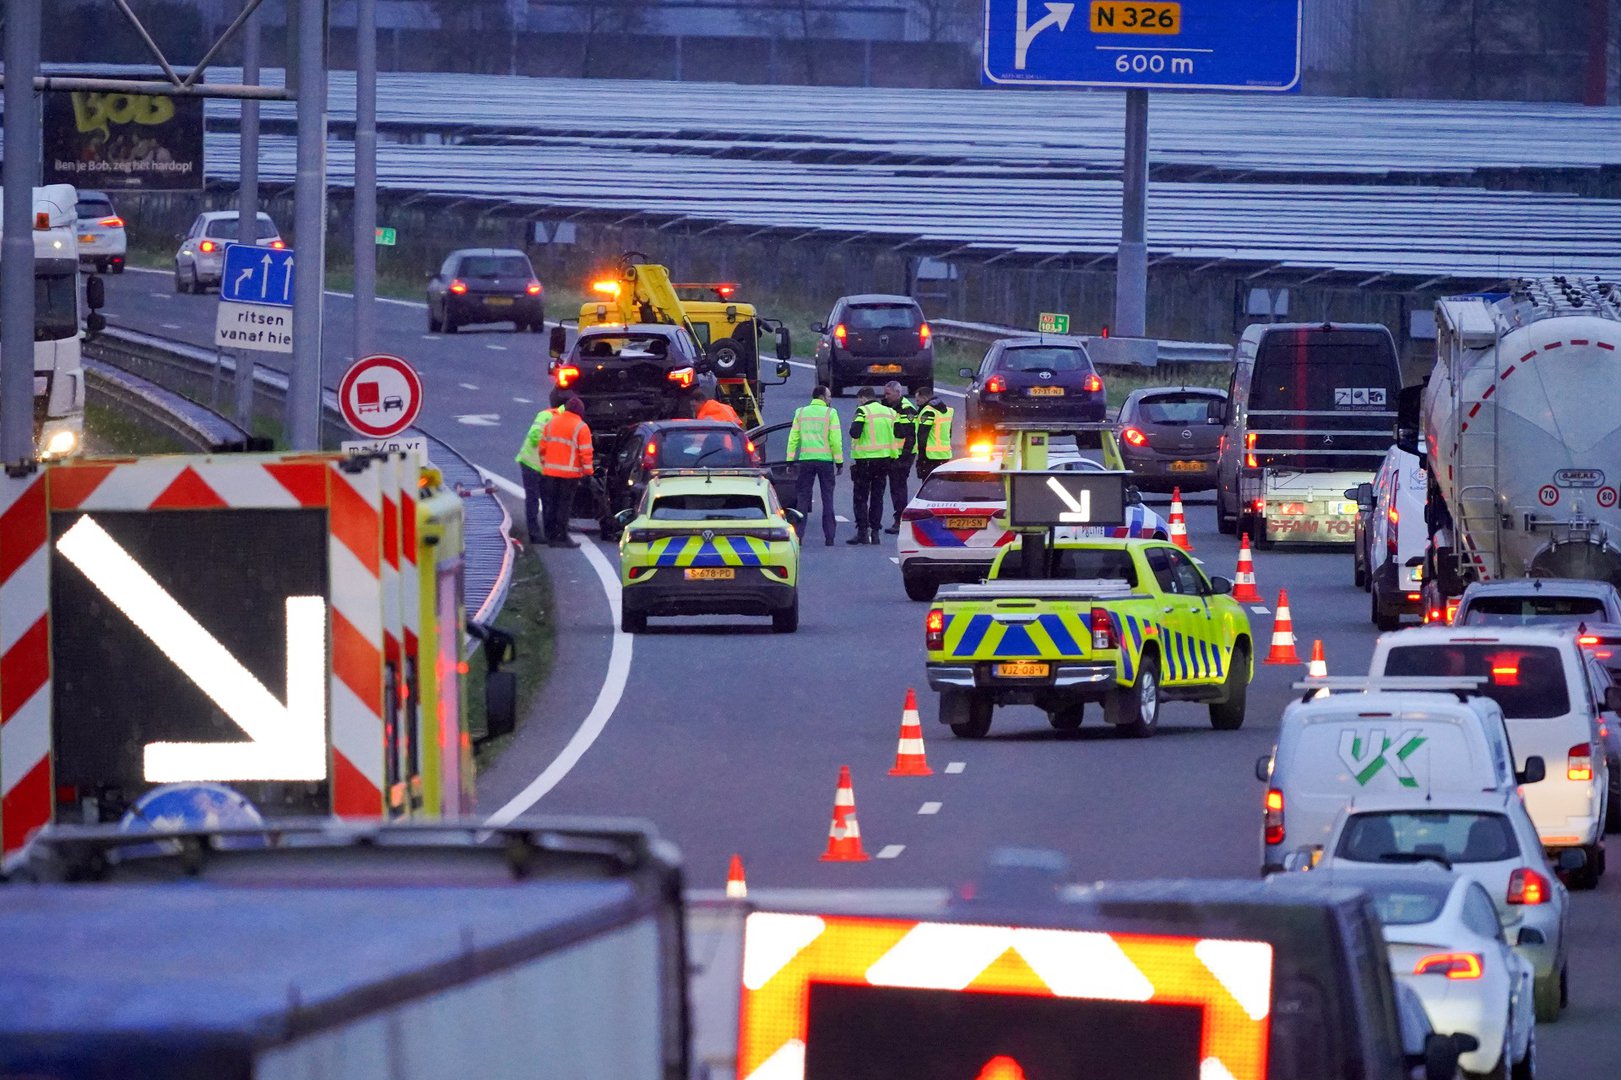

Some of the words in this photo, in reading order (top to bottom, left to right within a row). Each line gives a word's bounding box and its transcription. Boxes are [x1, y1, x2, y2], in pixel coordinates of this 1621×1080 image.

[1097, 7, 1114, 26] N
[1122, 7, 1174, 28] 326
[1115, 54, 1165, 73] 600
[1171, 58, 1194, 74] m
[54, 159, 76, 170] Ben
[76, 160, 86, 173] je
[113, 162, 132, 173] zeg
[238, 311, 284, 326] ritsen
[220, 329, 264, 342] vanaf
[268, 332, 291, 345] hie
[406, 442, 420, 450] vr
[1544, 490, 1554, 500] 70
[1602, 491, 1613, 501] 80
[1268, 520, 1319, 533] STAM
[1325, 520, 1355, 534] TO
[690, 569, 732, 578] S-678-PD
[1001, 665, 1046, 675] VJZ-08-V
